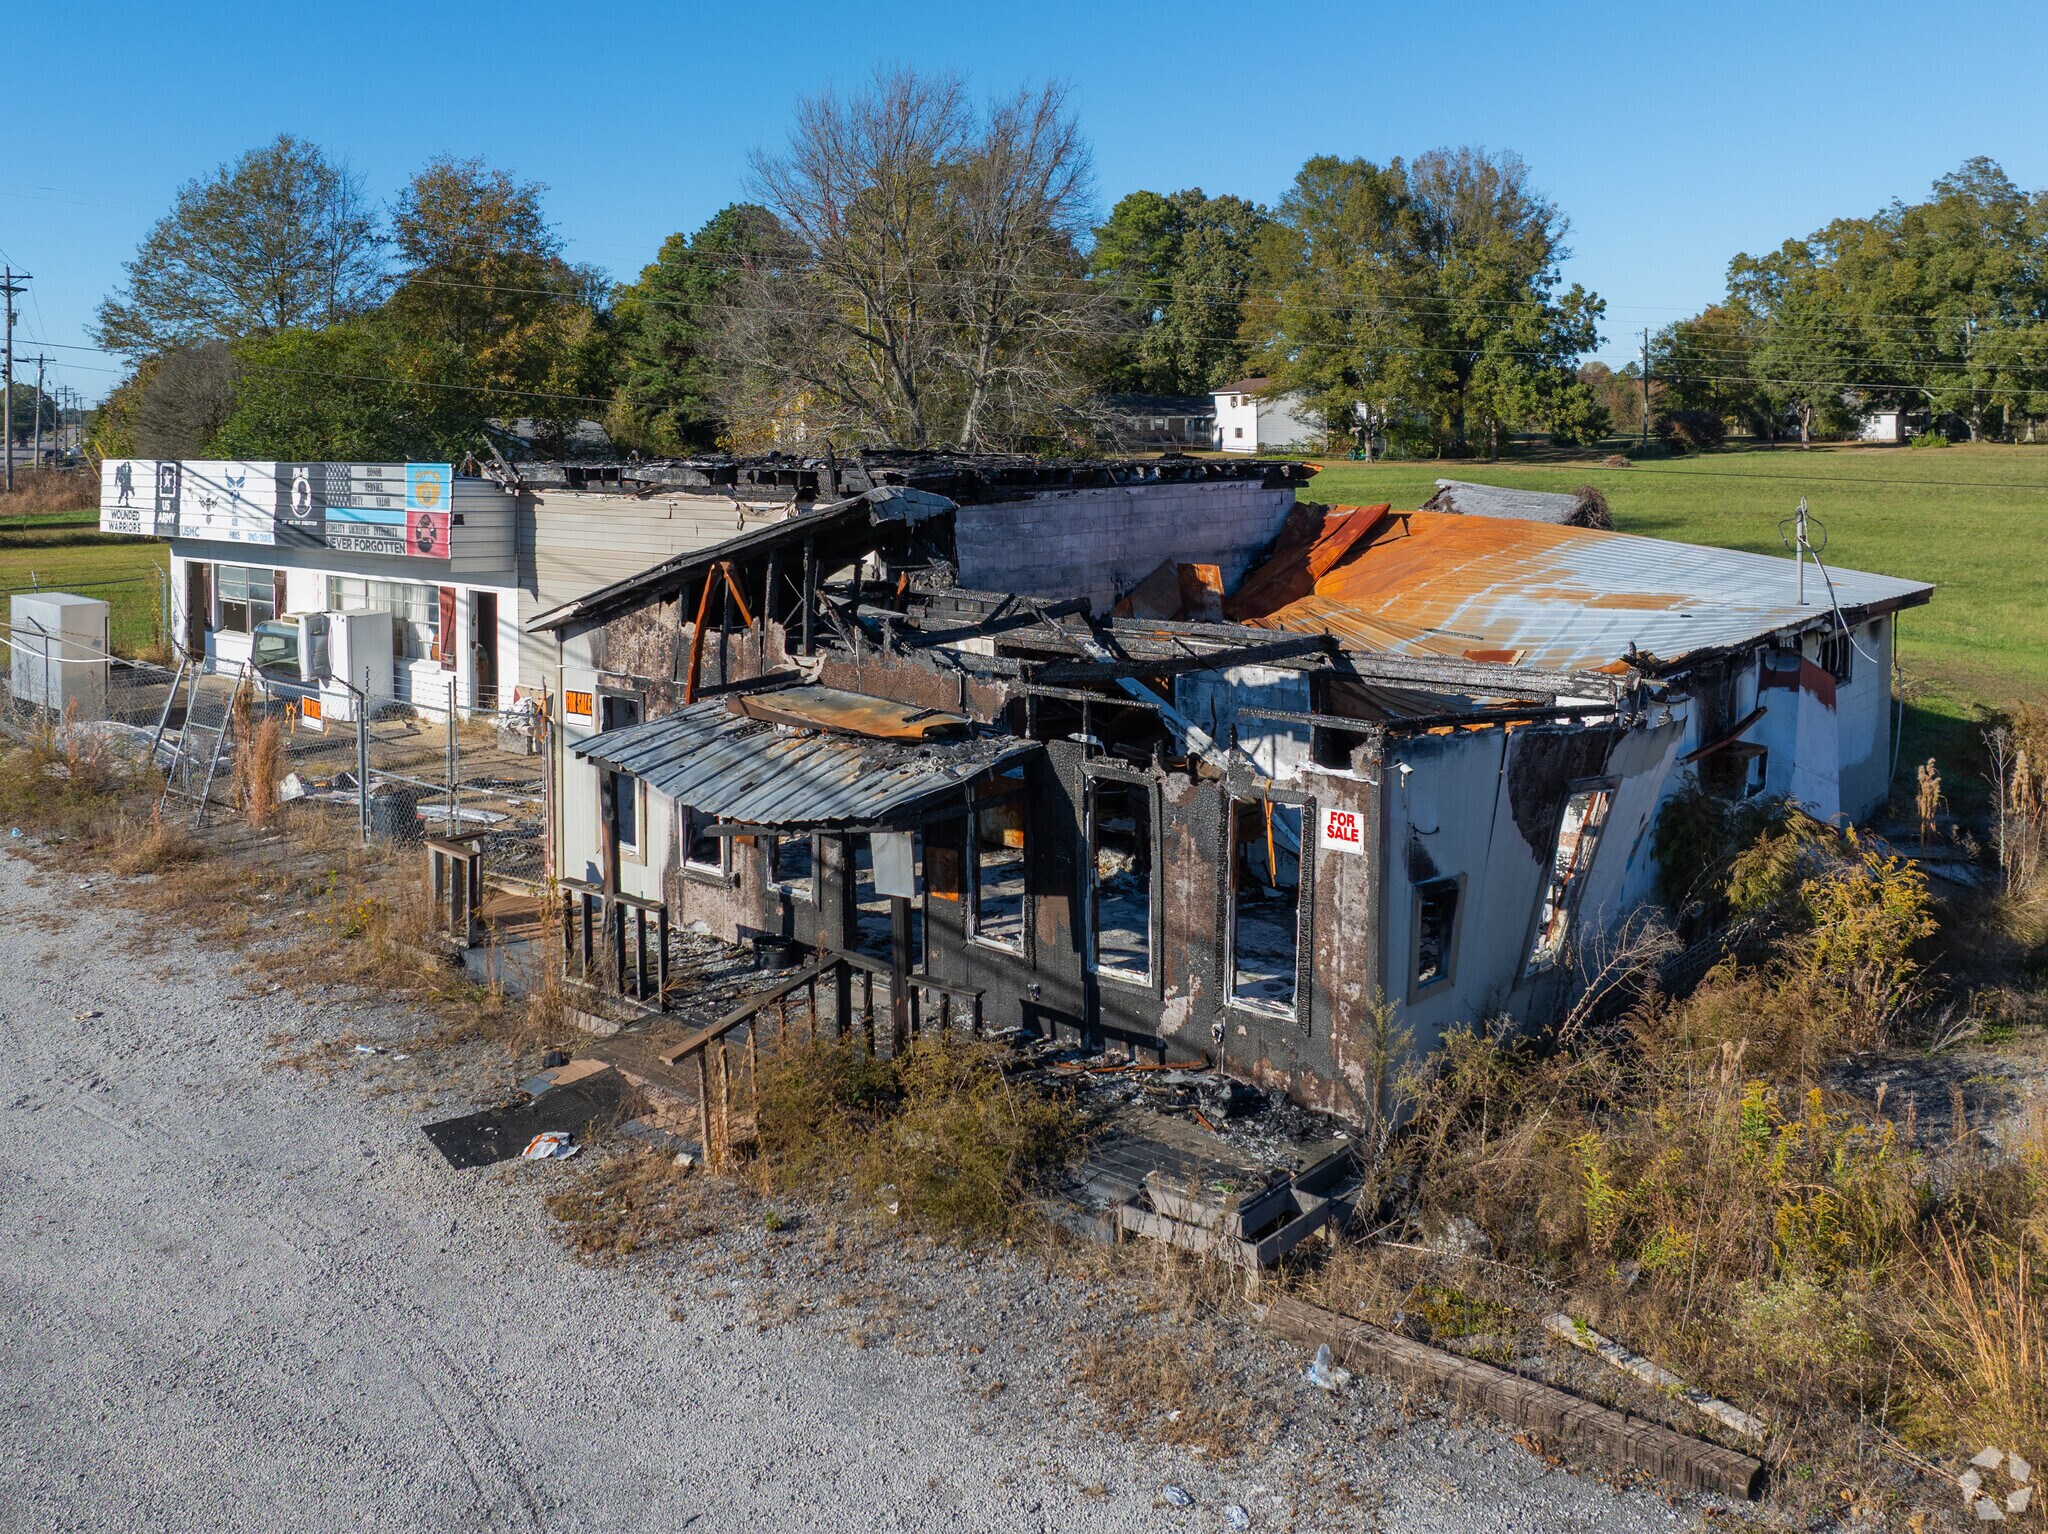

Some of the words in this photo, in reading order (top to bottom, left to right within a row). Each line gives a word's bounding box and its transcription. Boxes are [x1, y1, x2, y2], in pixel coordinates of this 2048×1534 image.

[364, 482, 384, 492] SERVICE
[161, 500, 171, 511] US
[111, 510, 140, 521] WOUNDED
[158, 512, 176, 524] ARMY
[109, 521, 142, 533] WARRIORS
[181, 526, 200, 538] USMC
[326, 524, 345, 533] FIDELITY
[326, 537, 352, 550] NEVER
[354, 539, 406, 554] FORGOTTEN
[566, 691, 576, 713] FOR
[577, 693, 592, 715] SALE
[1330, 811, 1355, 827] FOR
[1327, 825, 1359, 842] SALE
